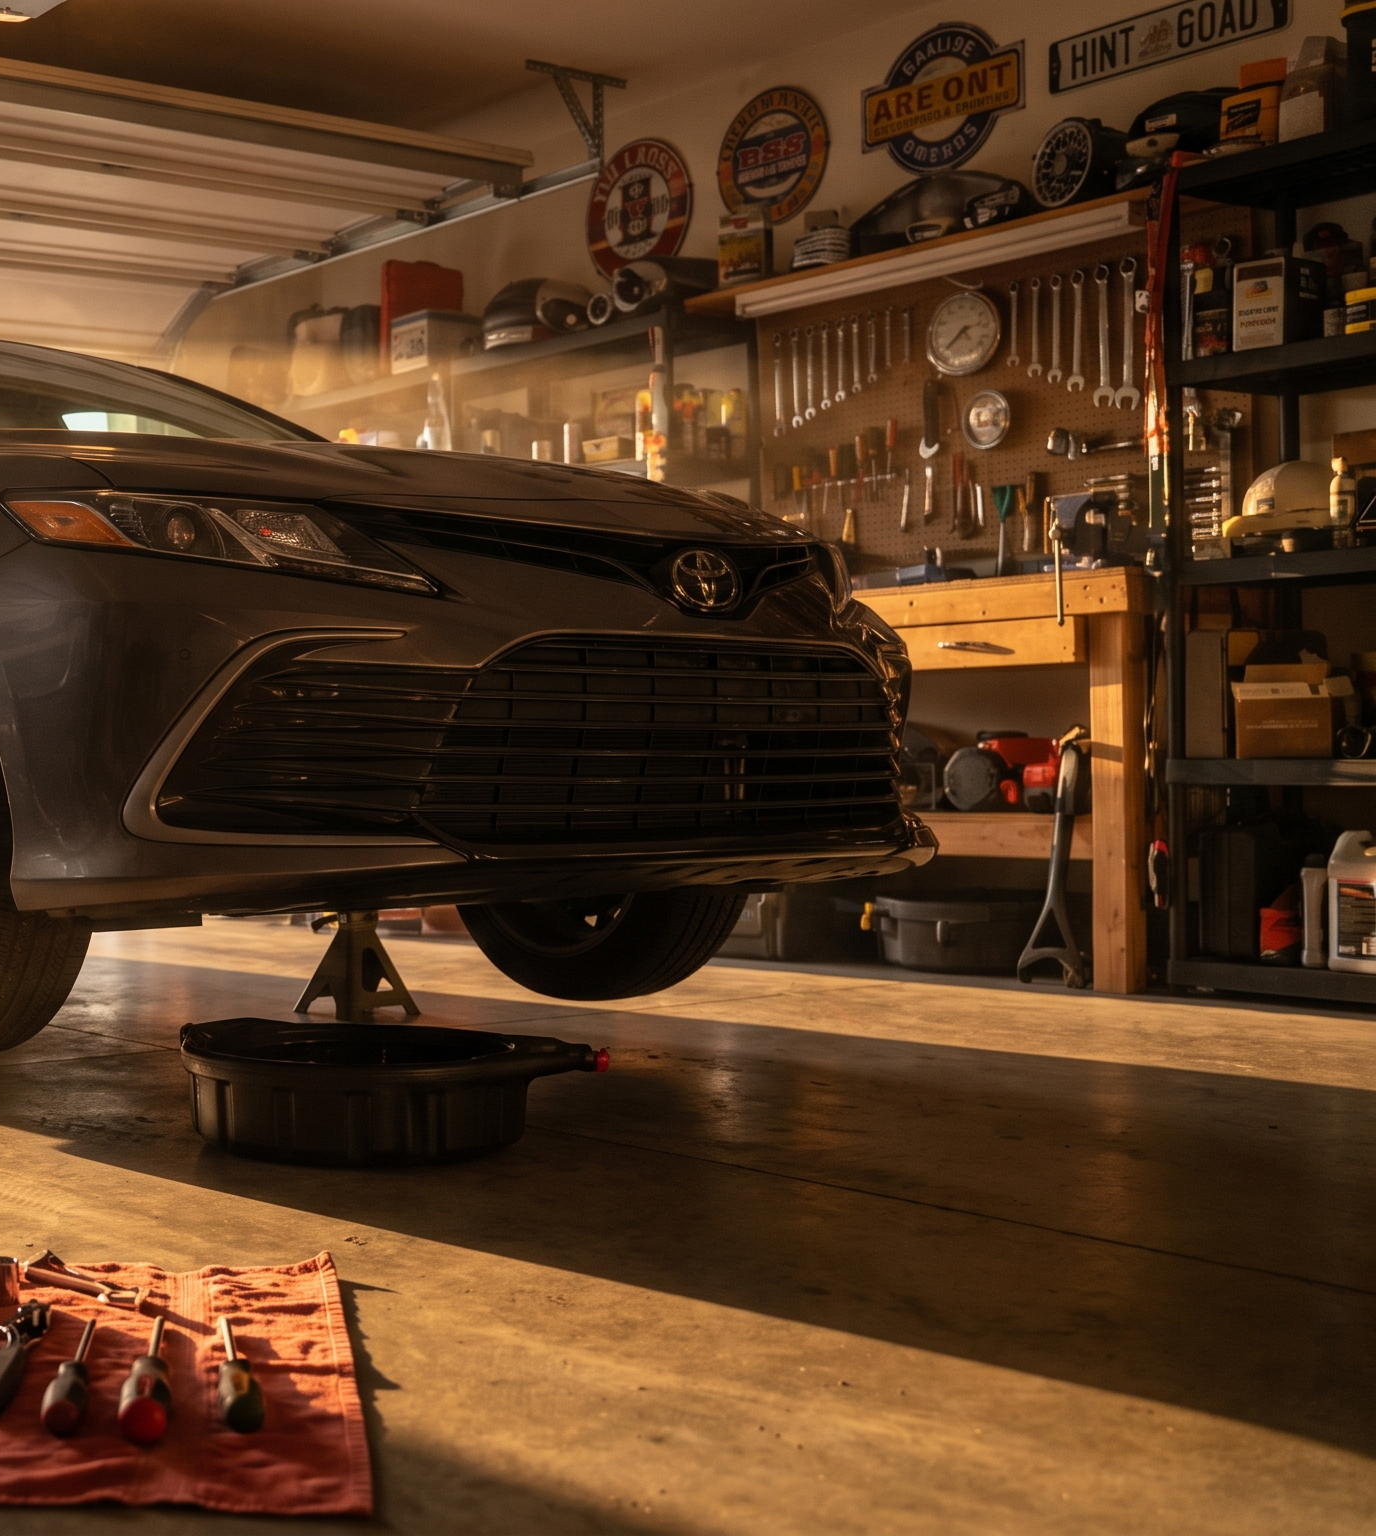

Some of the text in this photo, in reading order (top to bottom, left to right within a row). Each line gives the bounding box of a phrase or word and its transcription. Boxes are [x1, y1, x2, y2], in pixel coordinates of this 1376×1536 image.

[1071, 25, 1135, 80] HINT
[873, 61, 1011, 125] ARE ONT
